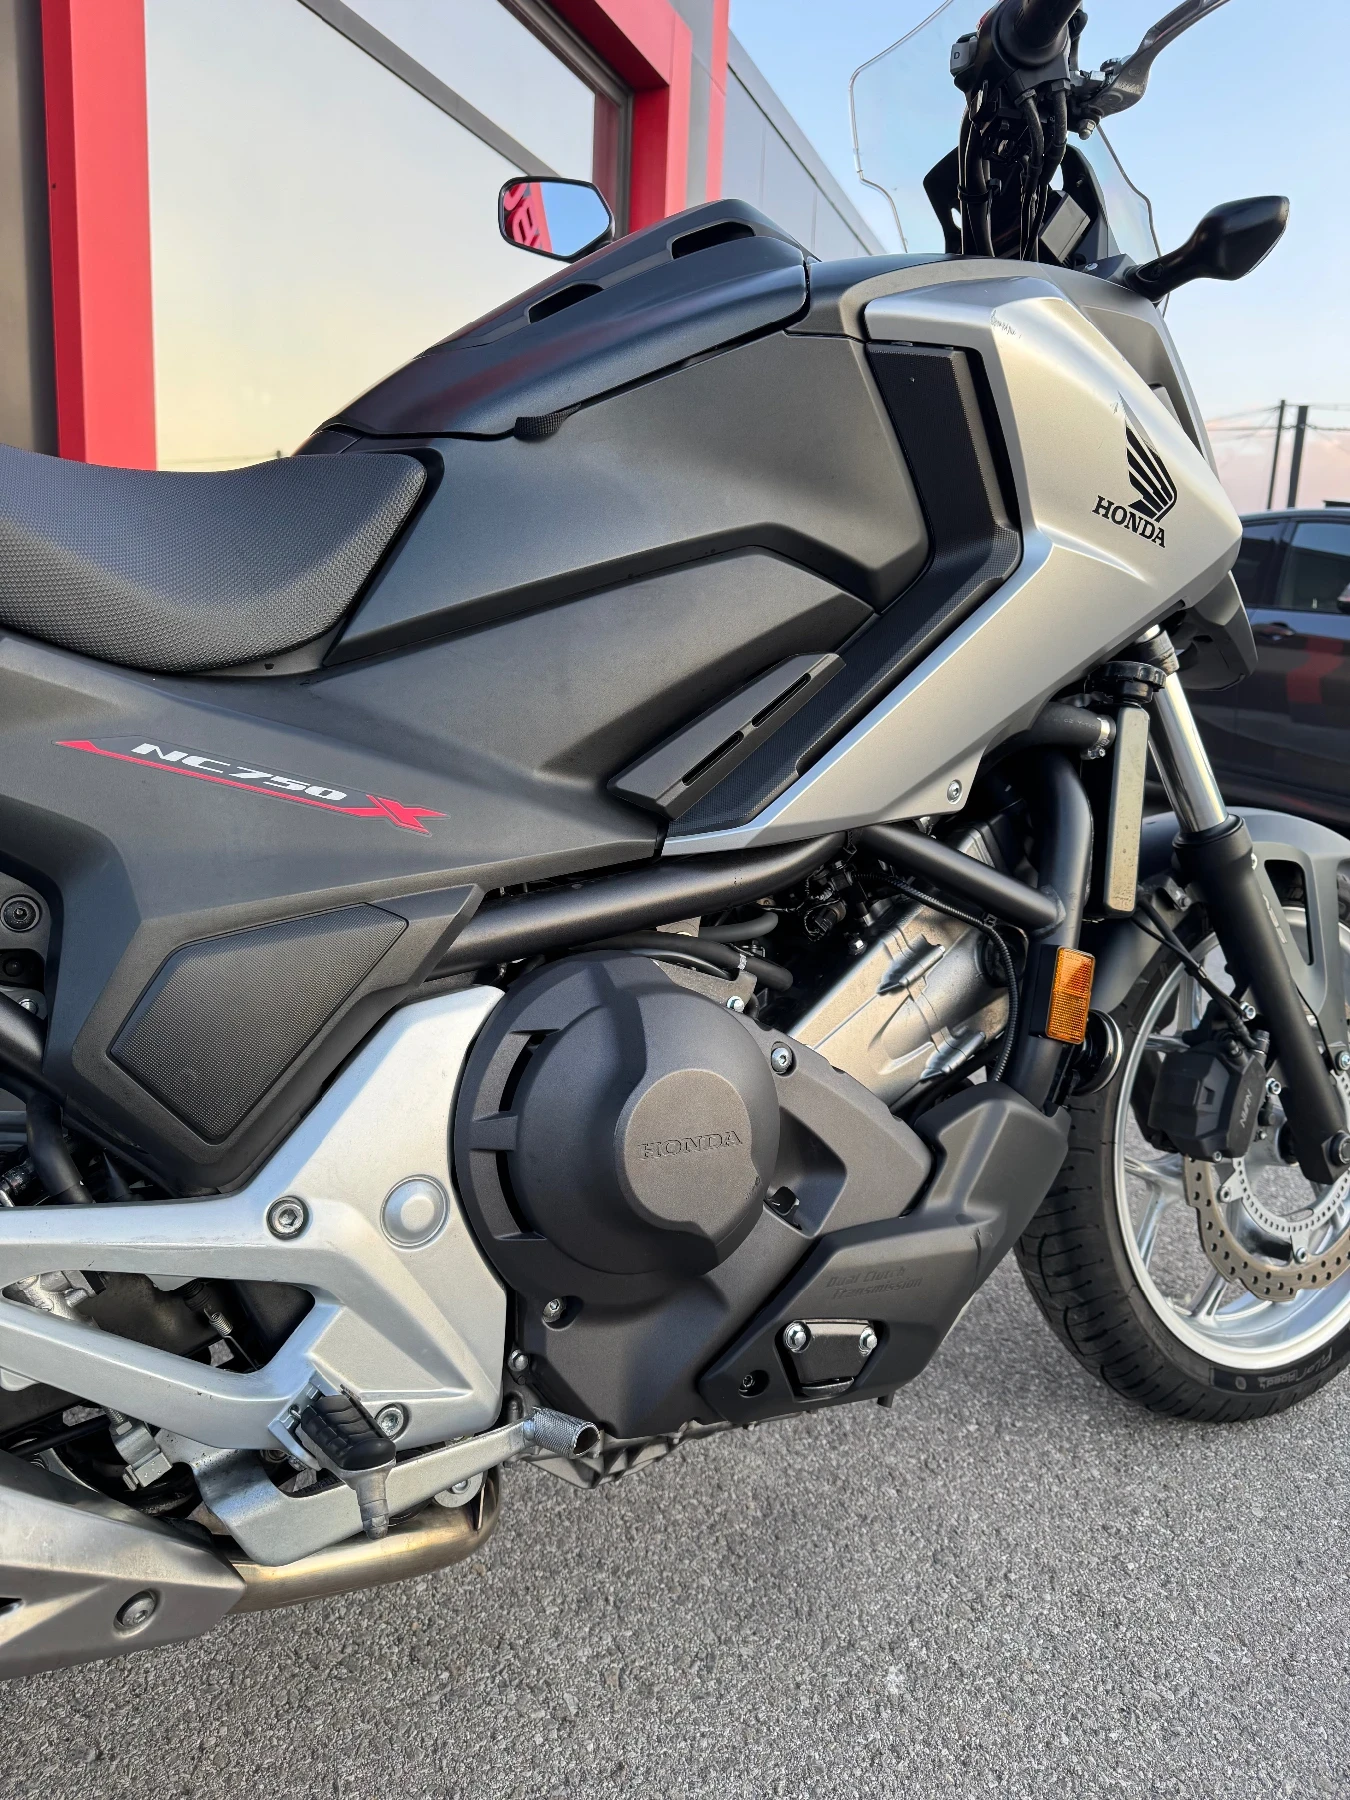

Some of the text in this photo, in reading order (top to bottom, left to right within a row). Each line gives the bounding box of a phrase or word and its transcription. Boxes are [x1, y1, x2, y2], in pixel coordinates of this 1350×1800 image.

[1092, 494, 1166, 548] HONDA
[638, 1130, 743, 1160] HONDA
[826, 1265, 905, 1288] Dual Clutch
[832, 1277, 923, 1300] Transmission
